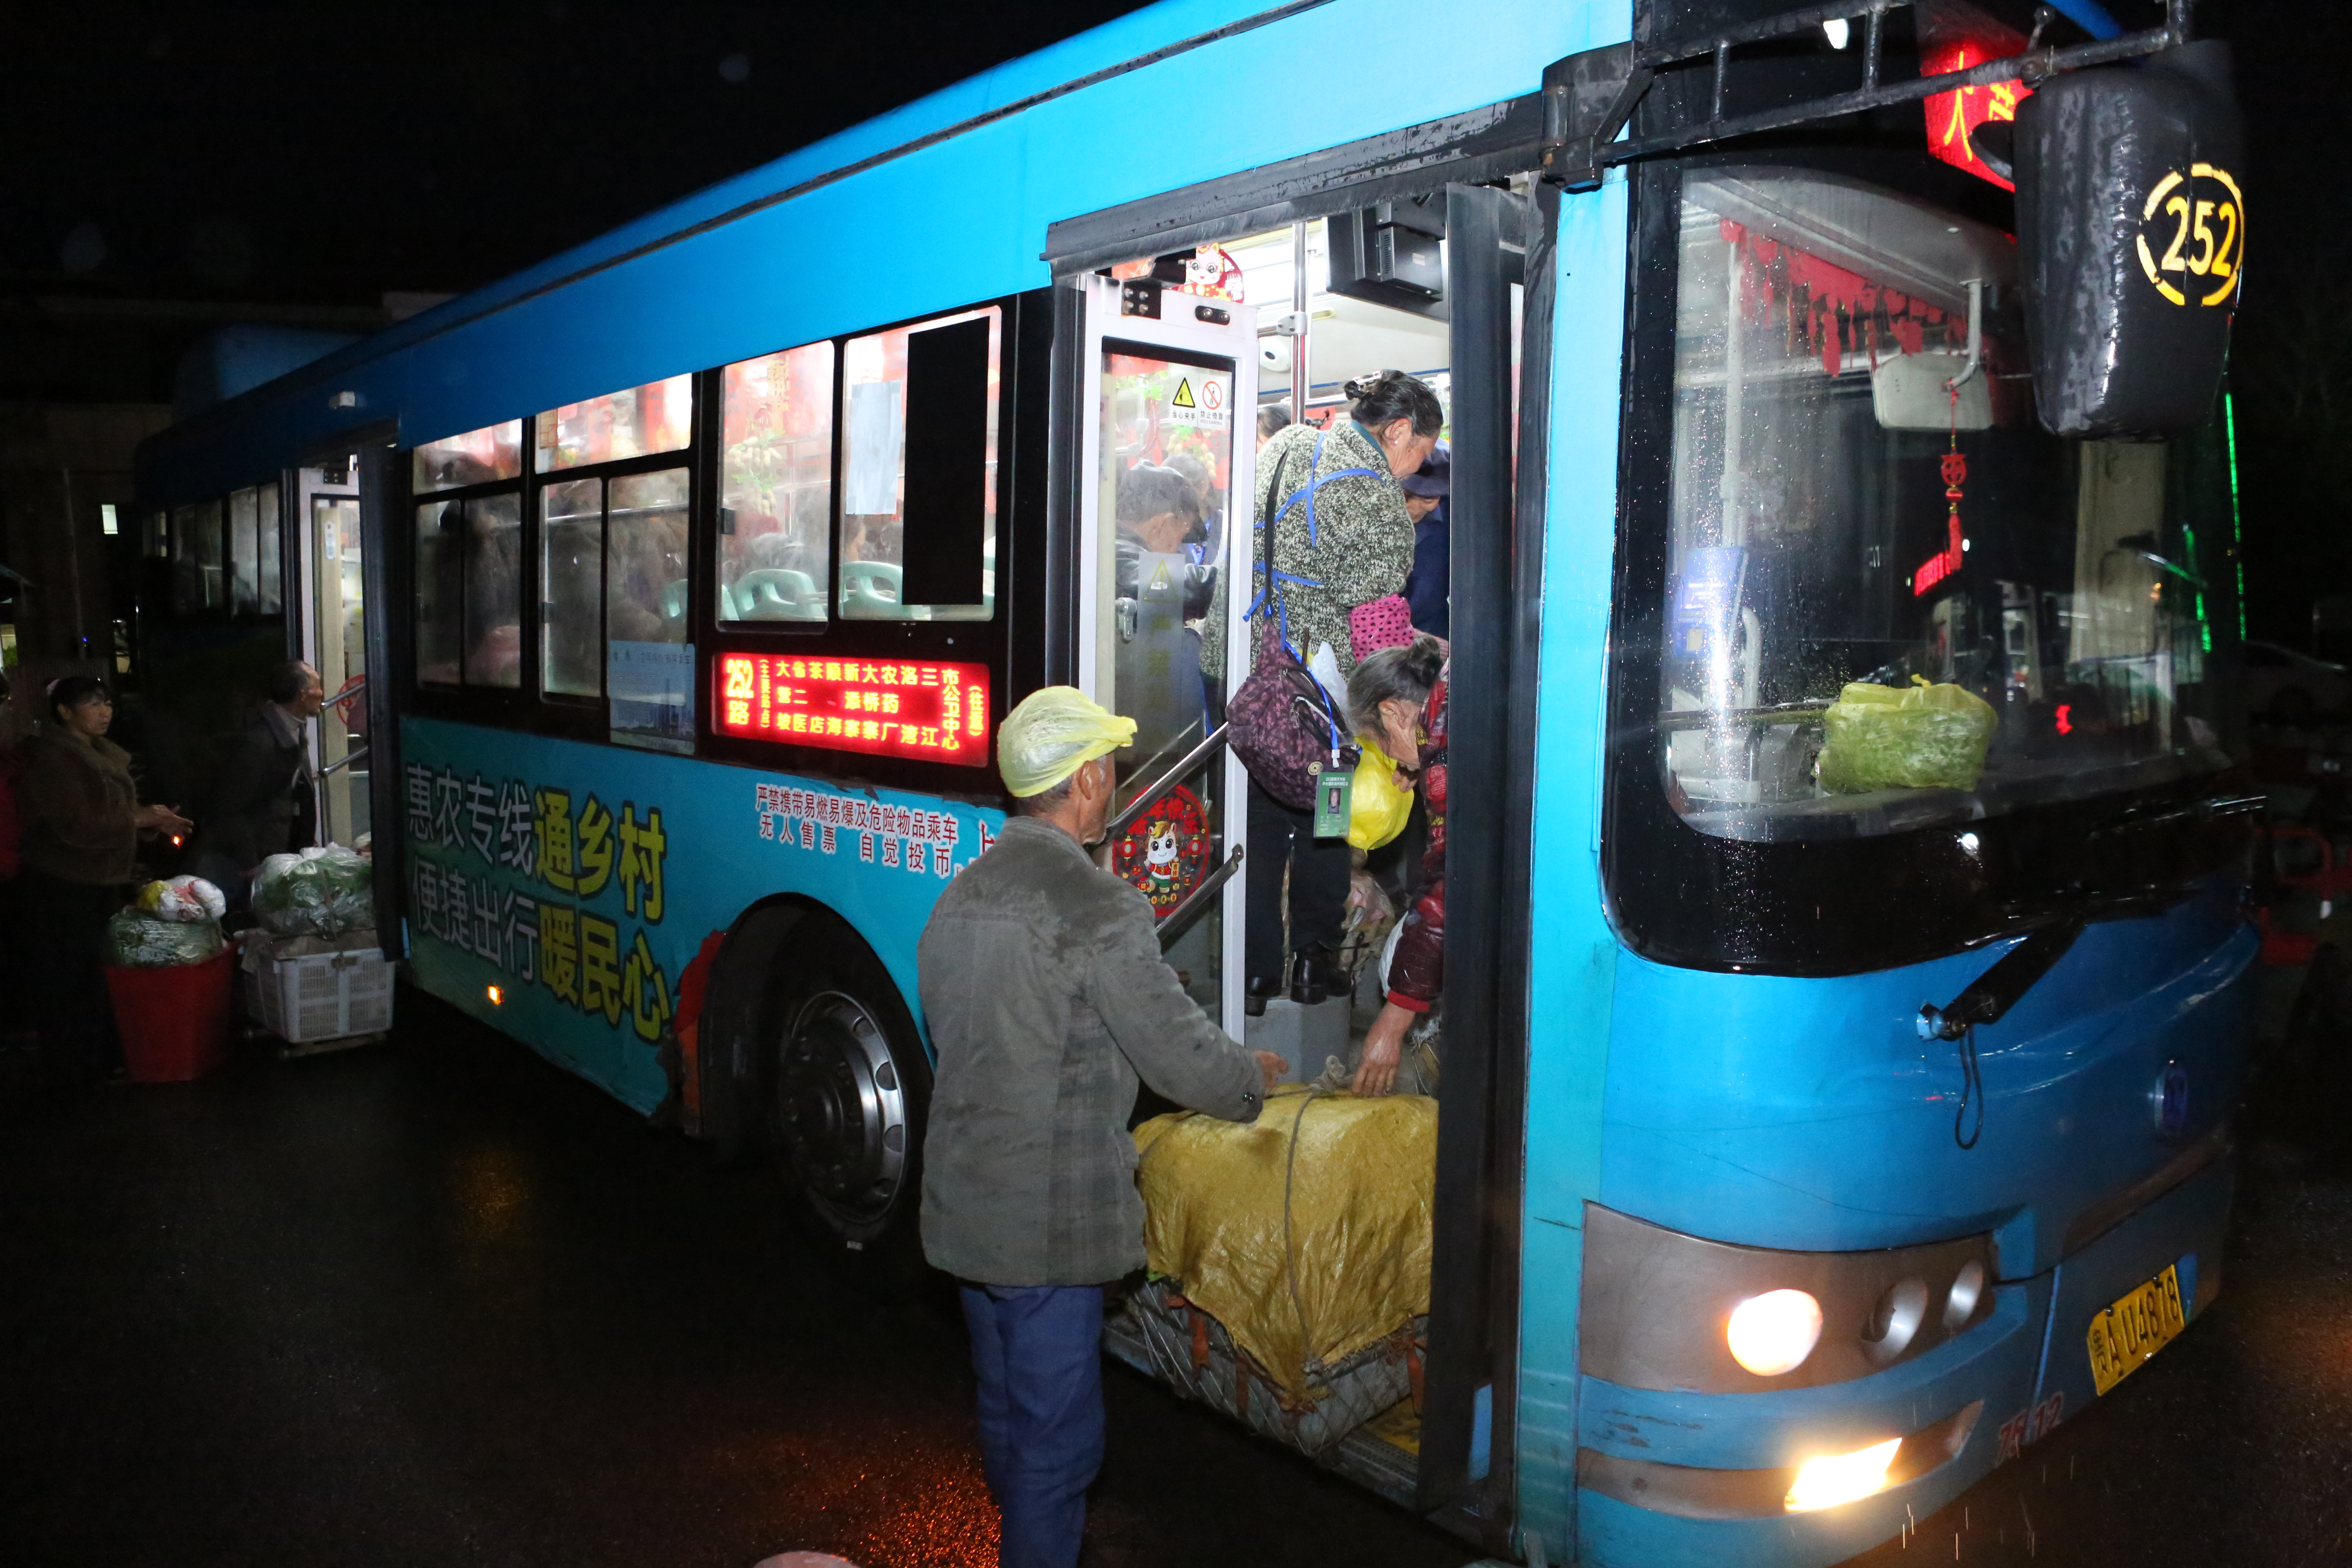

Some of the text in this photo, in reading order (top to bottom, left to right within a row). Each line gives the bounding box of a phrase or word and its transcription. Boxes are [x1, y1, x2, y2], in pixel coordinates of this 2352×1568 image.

[2161, 196, 2236, 277] 252
[1172, 410, 1195, 421] 当心夹手
[1200, 411, 1223, 420] 禁止倚靠
[726, 659, 754, 698] 252
[728, 700, 749, 725] 路
[942, 668, 960, 750] 市公卫中心
[407, 763, 664, 919] 惠农专线通乡村
[757, 786, 957, 845] 严禁携带易燃易爆及危险物品乘车
[760, 815, 950, 875] 无人售票 自觉投币
[412, 858, 670, 1040] 便捷出行暖民心
